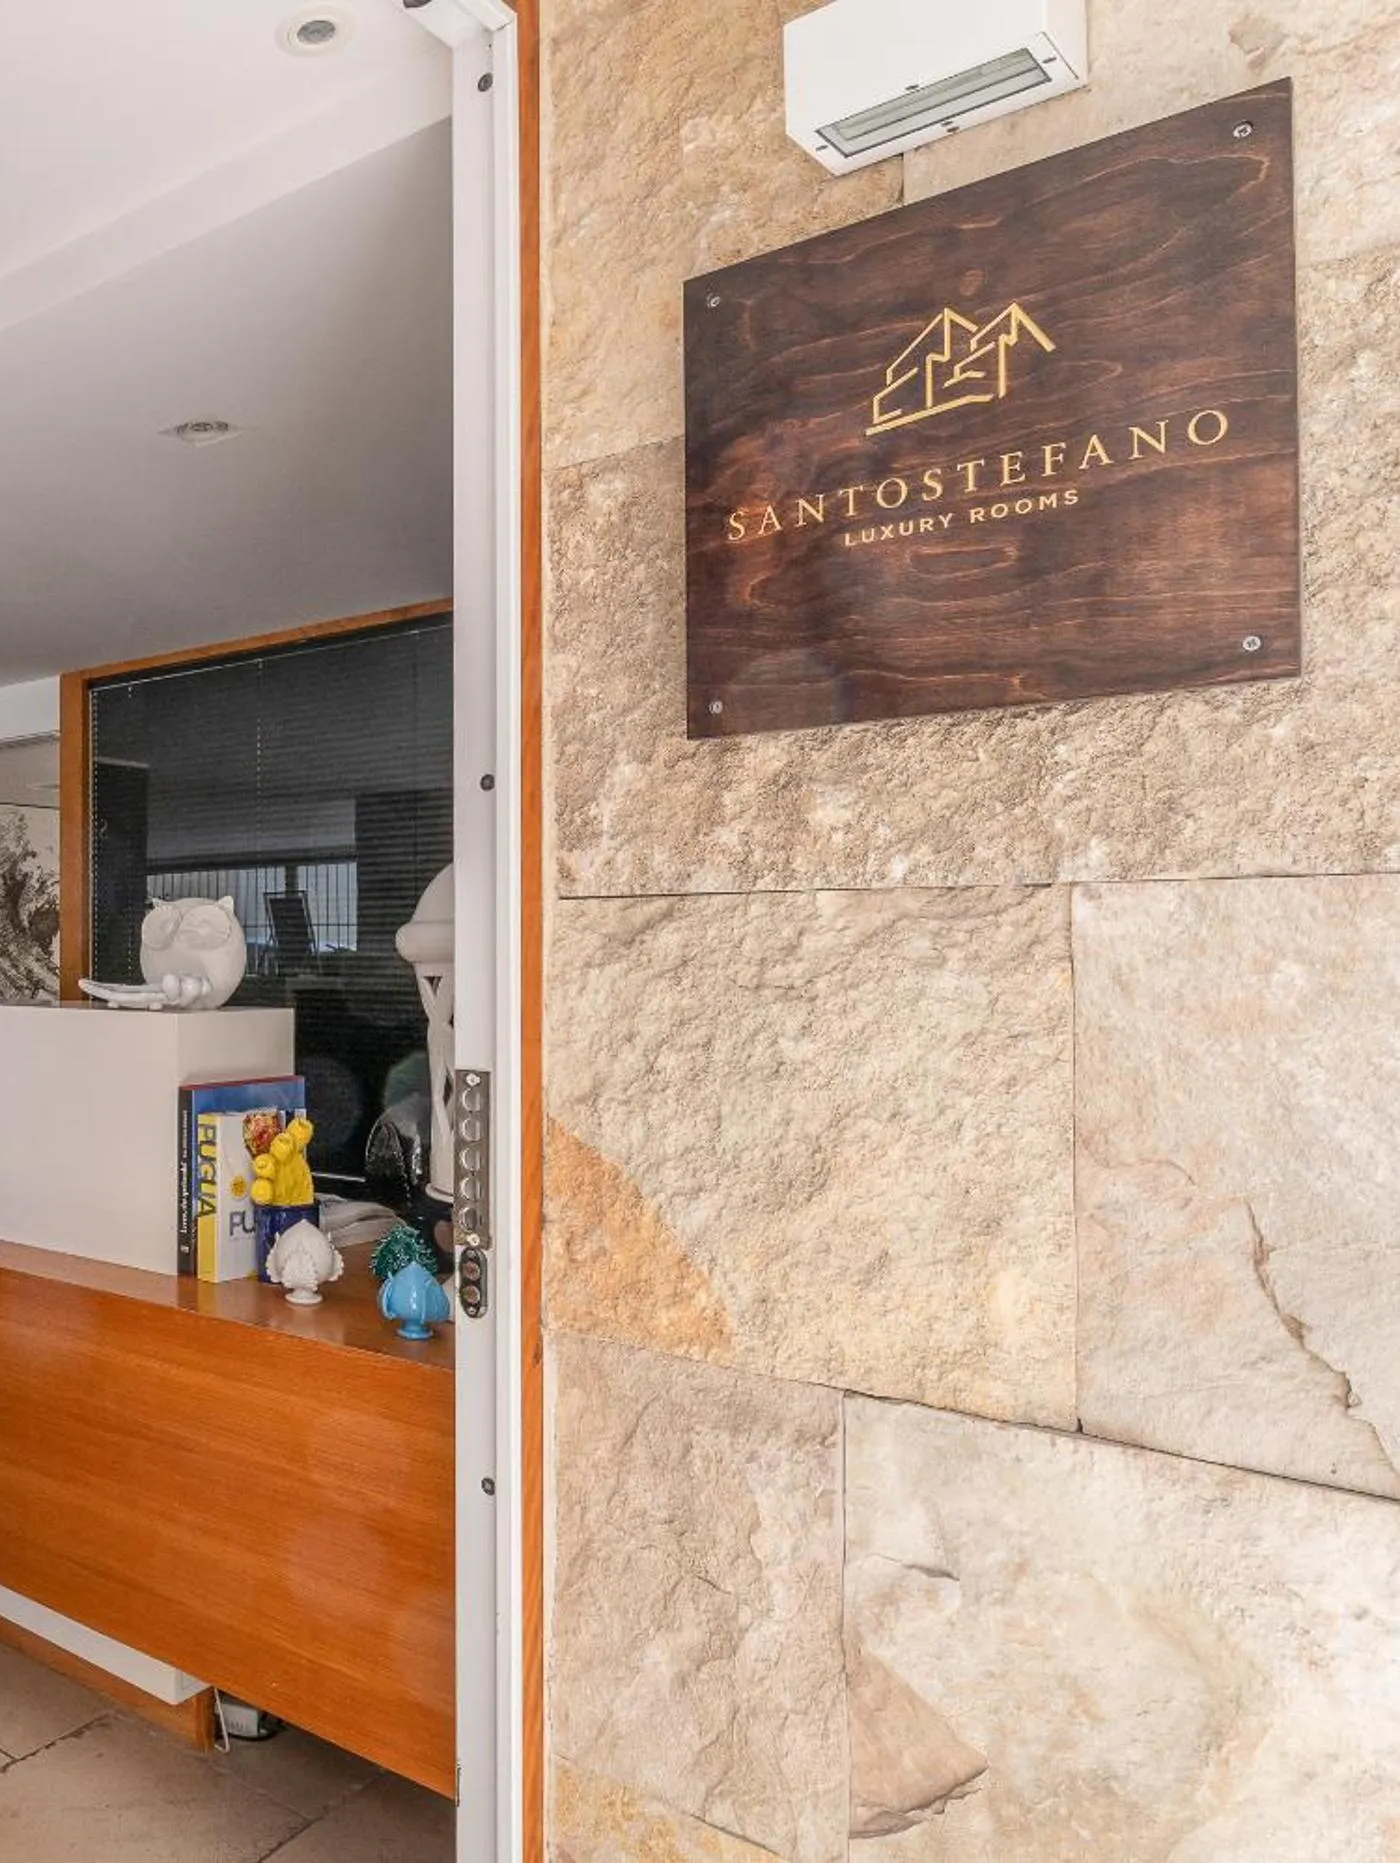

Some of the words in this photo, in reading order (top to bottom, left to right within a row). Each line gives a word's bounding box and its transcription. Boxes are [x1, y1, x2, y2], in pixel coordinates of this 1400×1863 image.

[728, 410, 1229, 541] SANTOSTEFANO
[844, 513, 953, 546] LUXURY
[970, 489, 1080, 523] ROOMS
